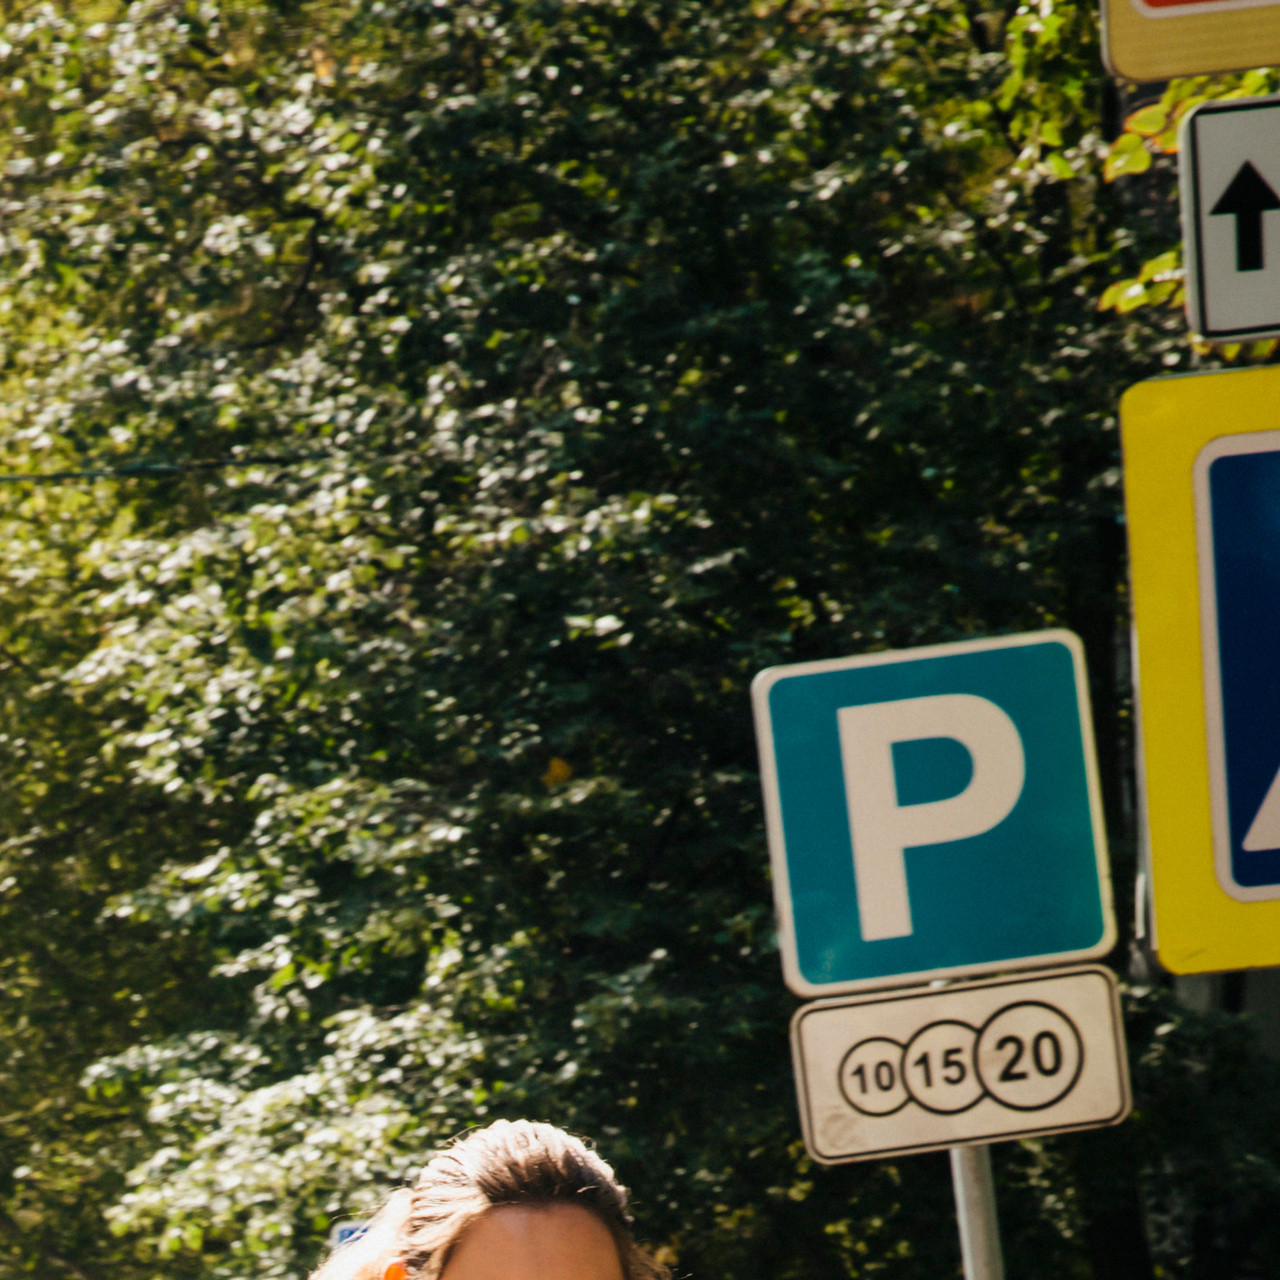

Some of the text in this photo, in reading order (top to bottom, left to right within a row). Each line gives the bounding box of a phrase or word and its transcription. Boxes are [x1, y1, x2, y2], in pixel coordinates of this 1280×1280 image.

[837, 693, 1025, 942] P
[851, 1031, 1063, 1094] 10 15 20
